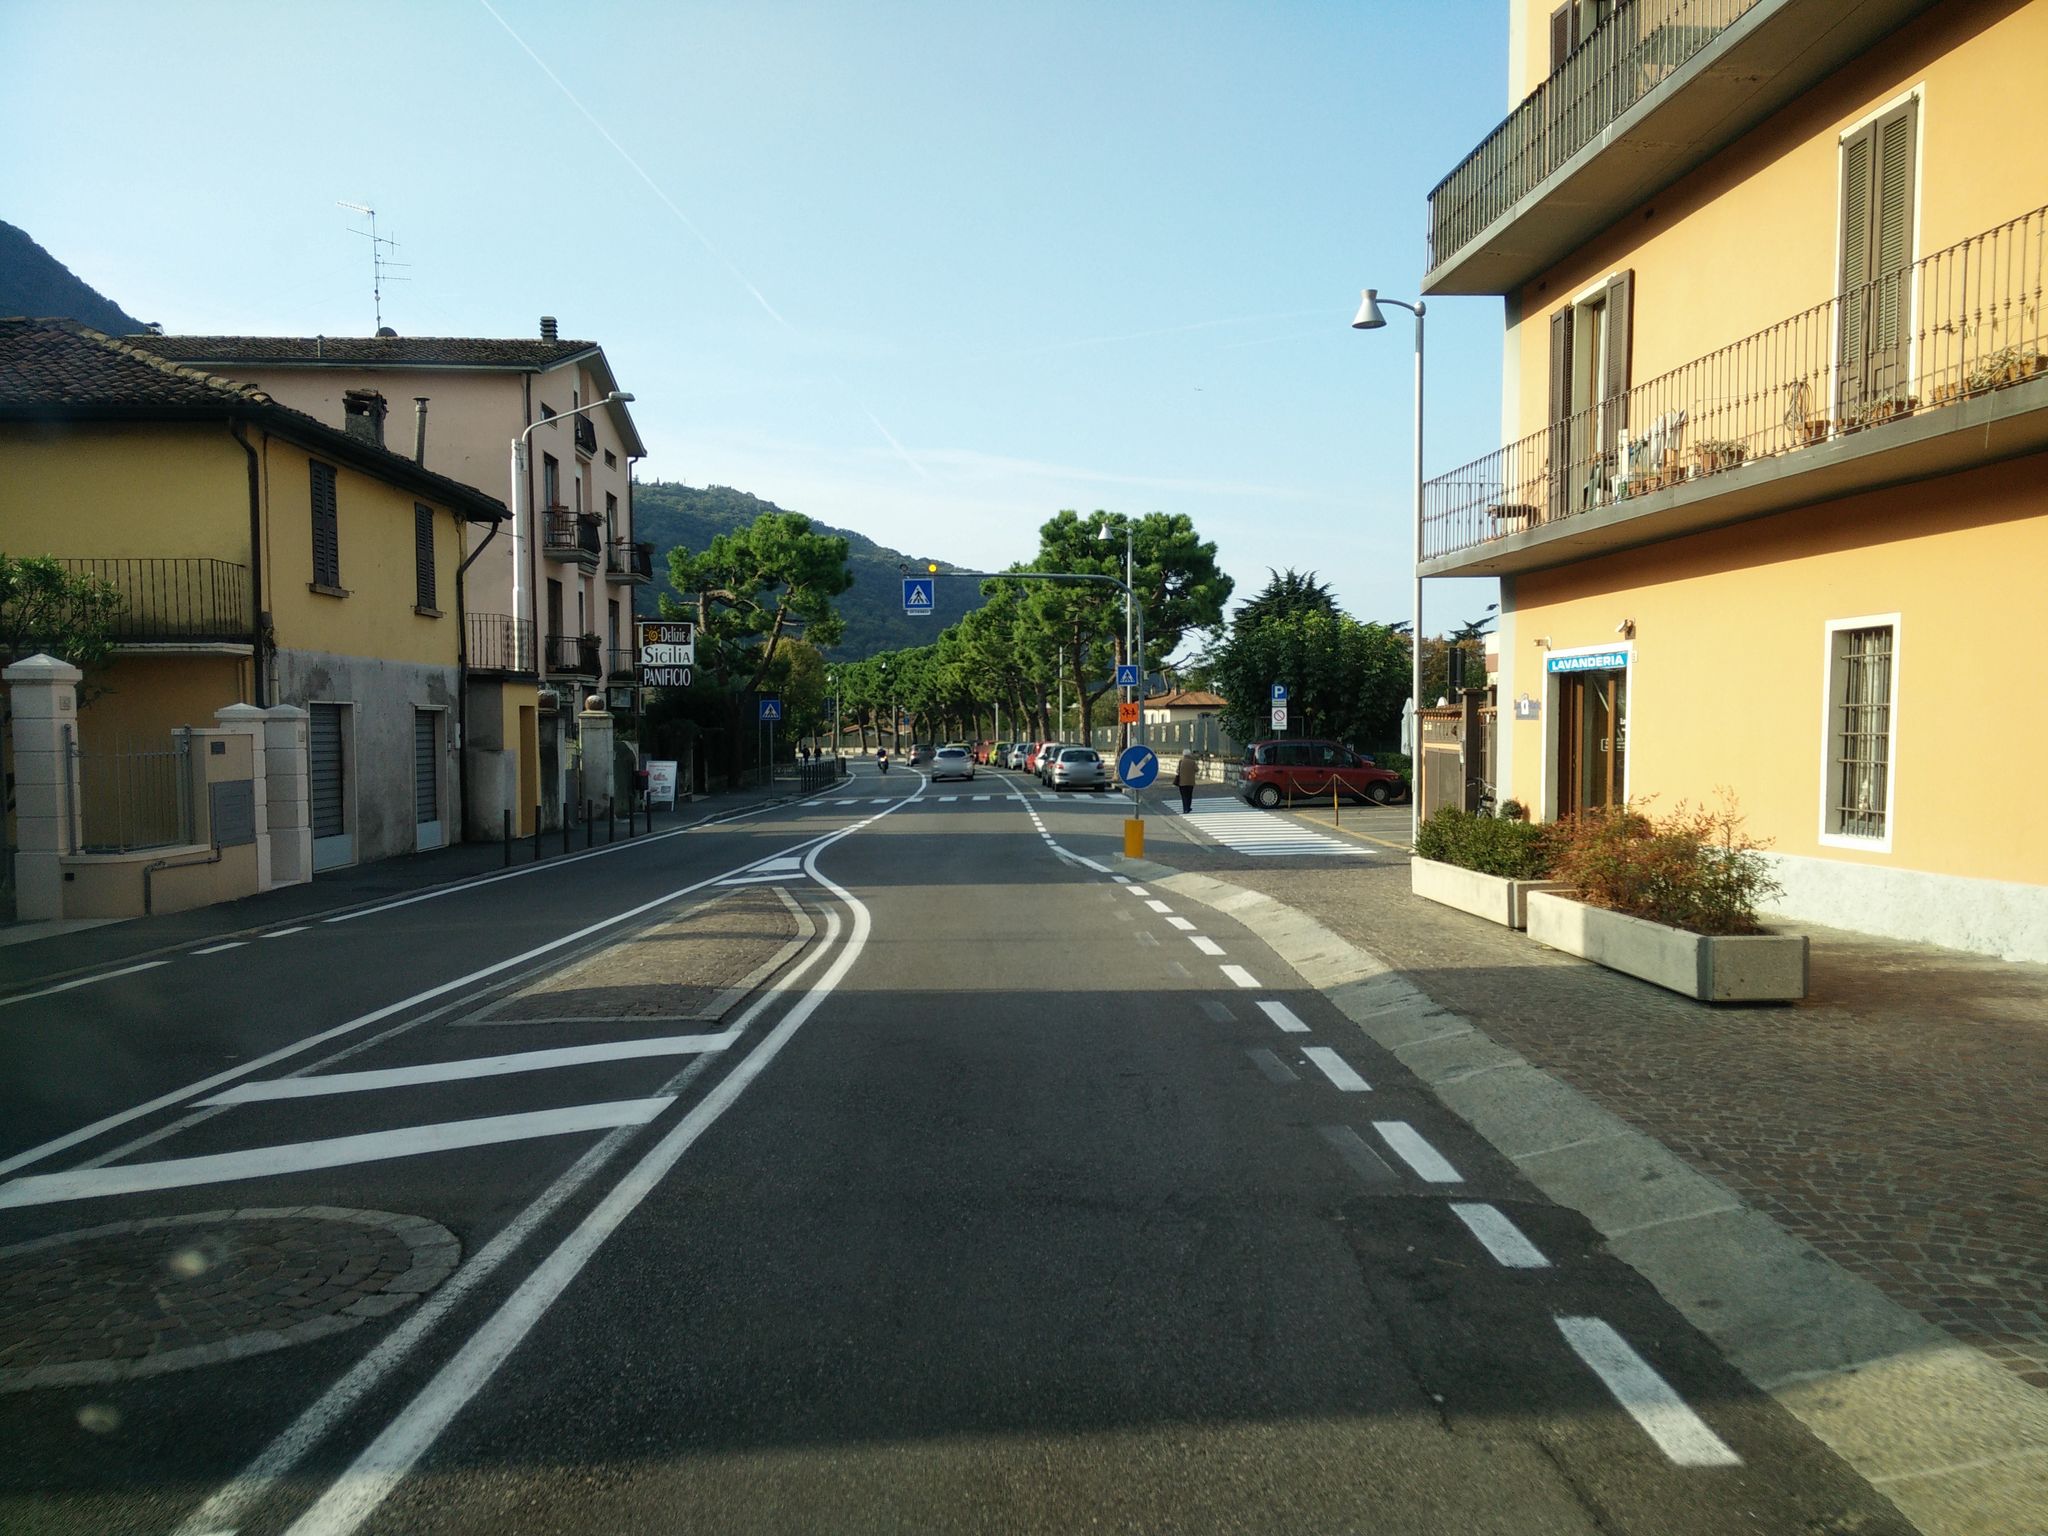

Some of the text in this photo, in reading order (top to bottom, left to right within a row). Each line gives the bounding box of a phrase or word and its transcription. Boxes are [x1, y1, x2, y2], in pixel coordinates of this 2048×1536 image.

[645, 646, 691, 663] Sicilia
[1552, 655, 1624, 670] LAVANDERIA
[644, 668, 691, 686] PANIFICIO
[1275, 686, 1284, 698] P
